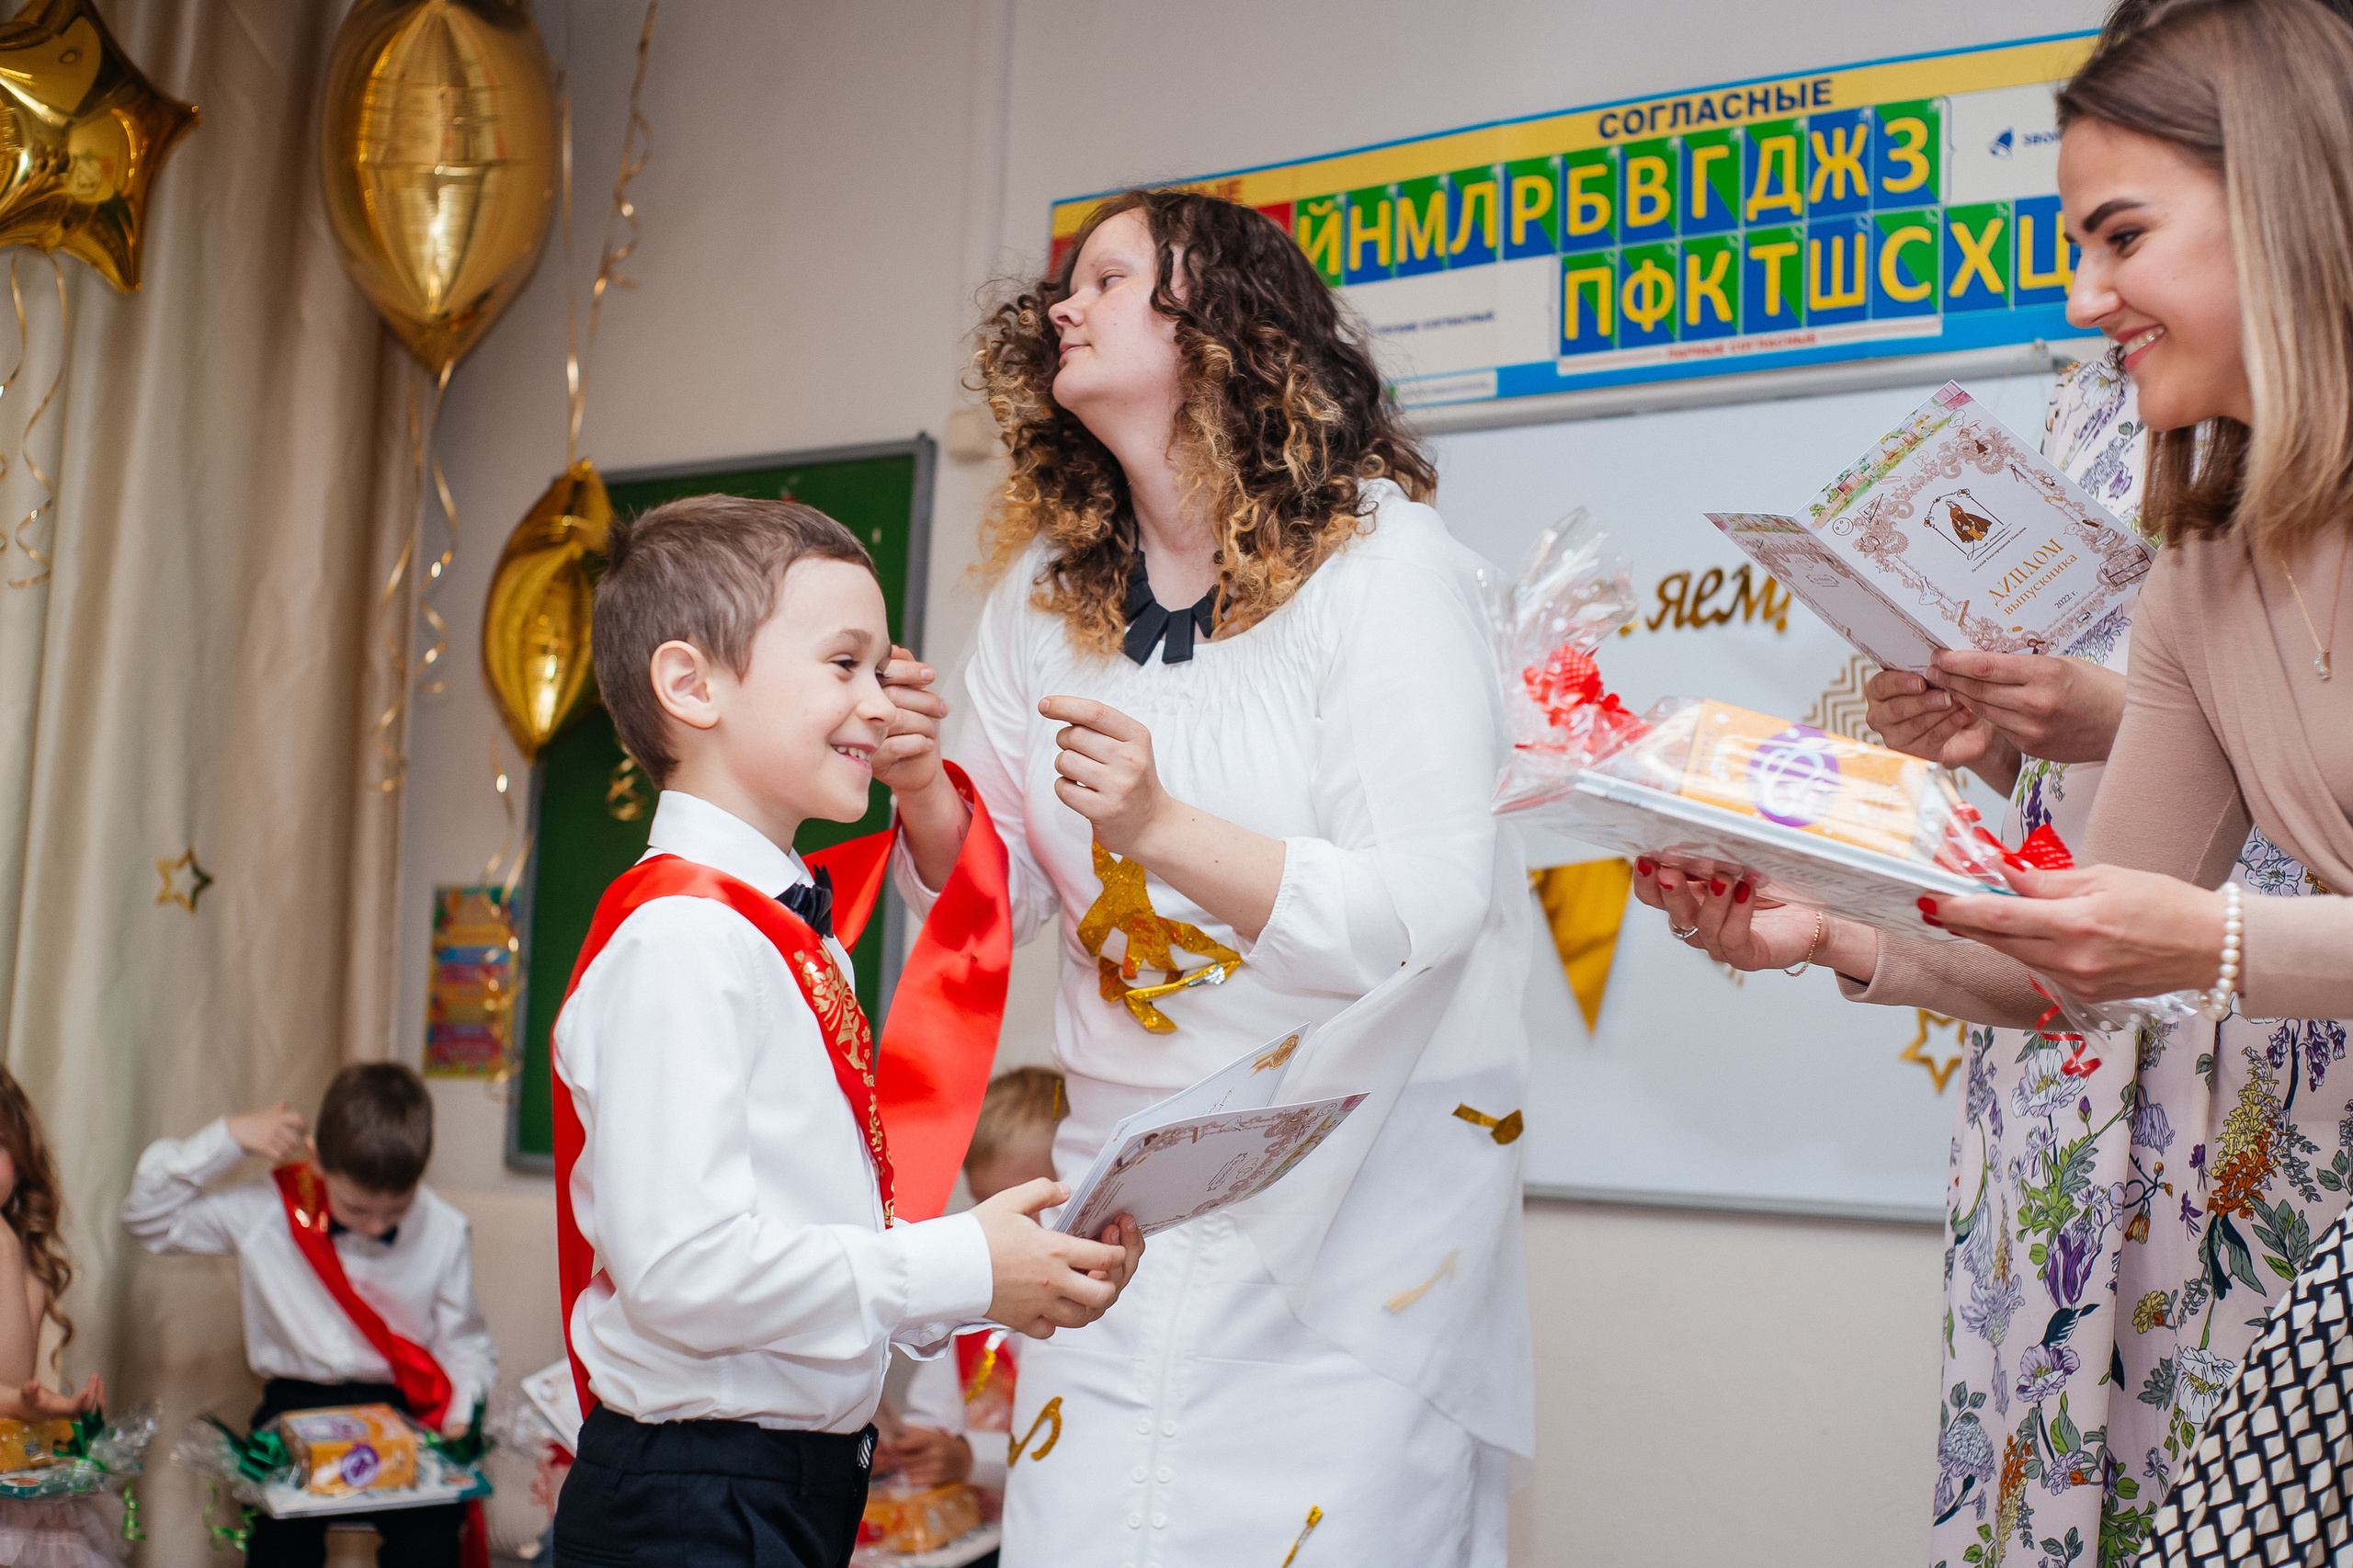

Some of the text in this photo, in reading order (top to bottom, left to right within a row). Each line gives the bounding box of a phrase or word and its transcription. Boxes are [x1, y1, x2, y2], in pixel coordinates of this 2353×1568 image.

[1598, 78, 1834, 139] СОГЛАСНЫЕ
[1988, 538, 2064, 608] ДИПЛОМ
[2004, 553, 2078, 616] выпускника
[2054, 594, 2072, 609] 2022
